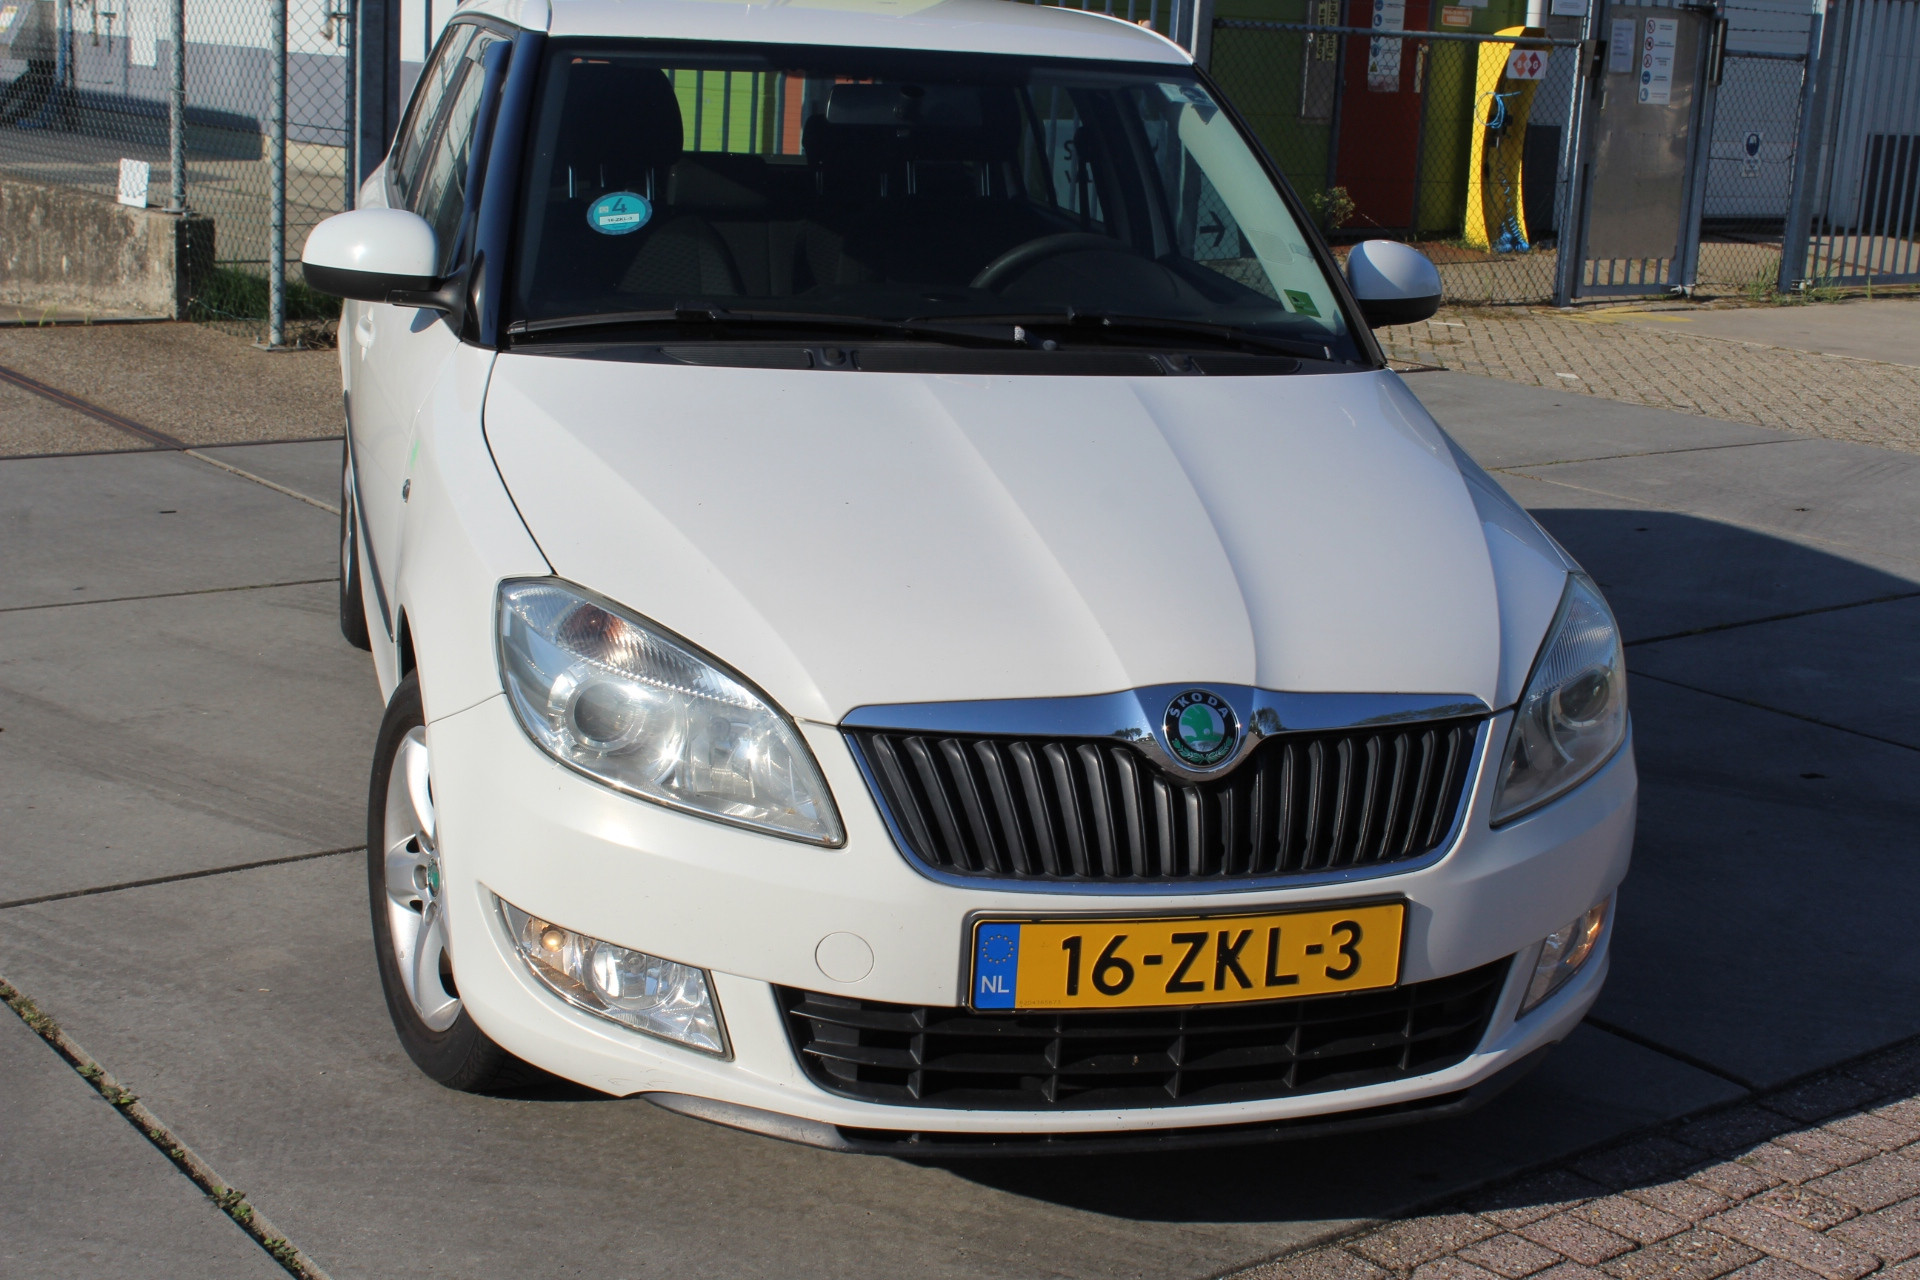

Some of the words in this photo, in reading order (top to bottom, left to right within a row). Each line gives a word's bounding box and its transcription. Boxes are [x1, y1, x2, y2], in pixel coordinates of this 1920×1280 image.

[612, 198, 627, 213] 4
[1061, 919, 1364, 997] 16-ZKL-3
[981, 975, 1010, 994] NL
